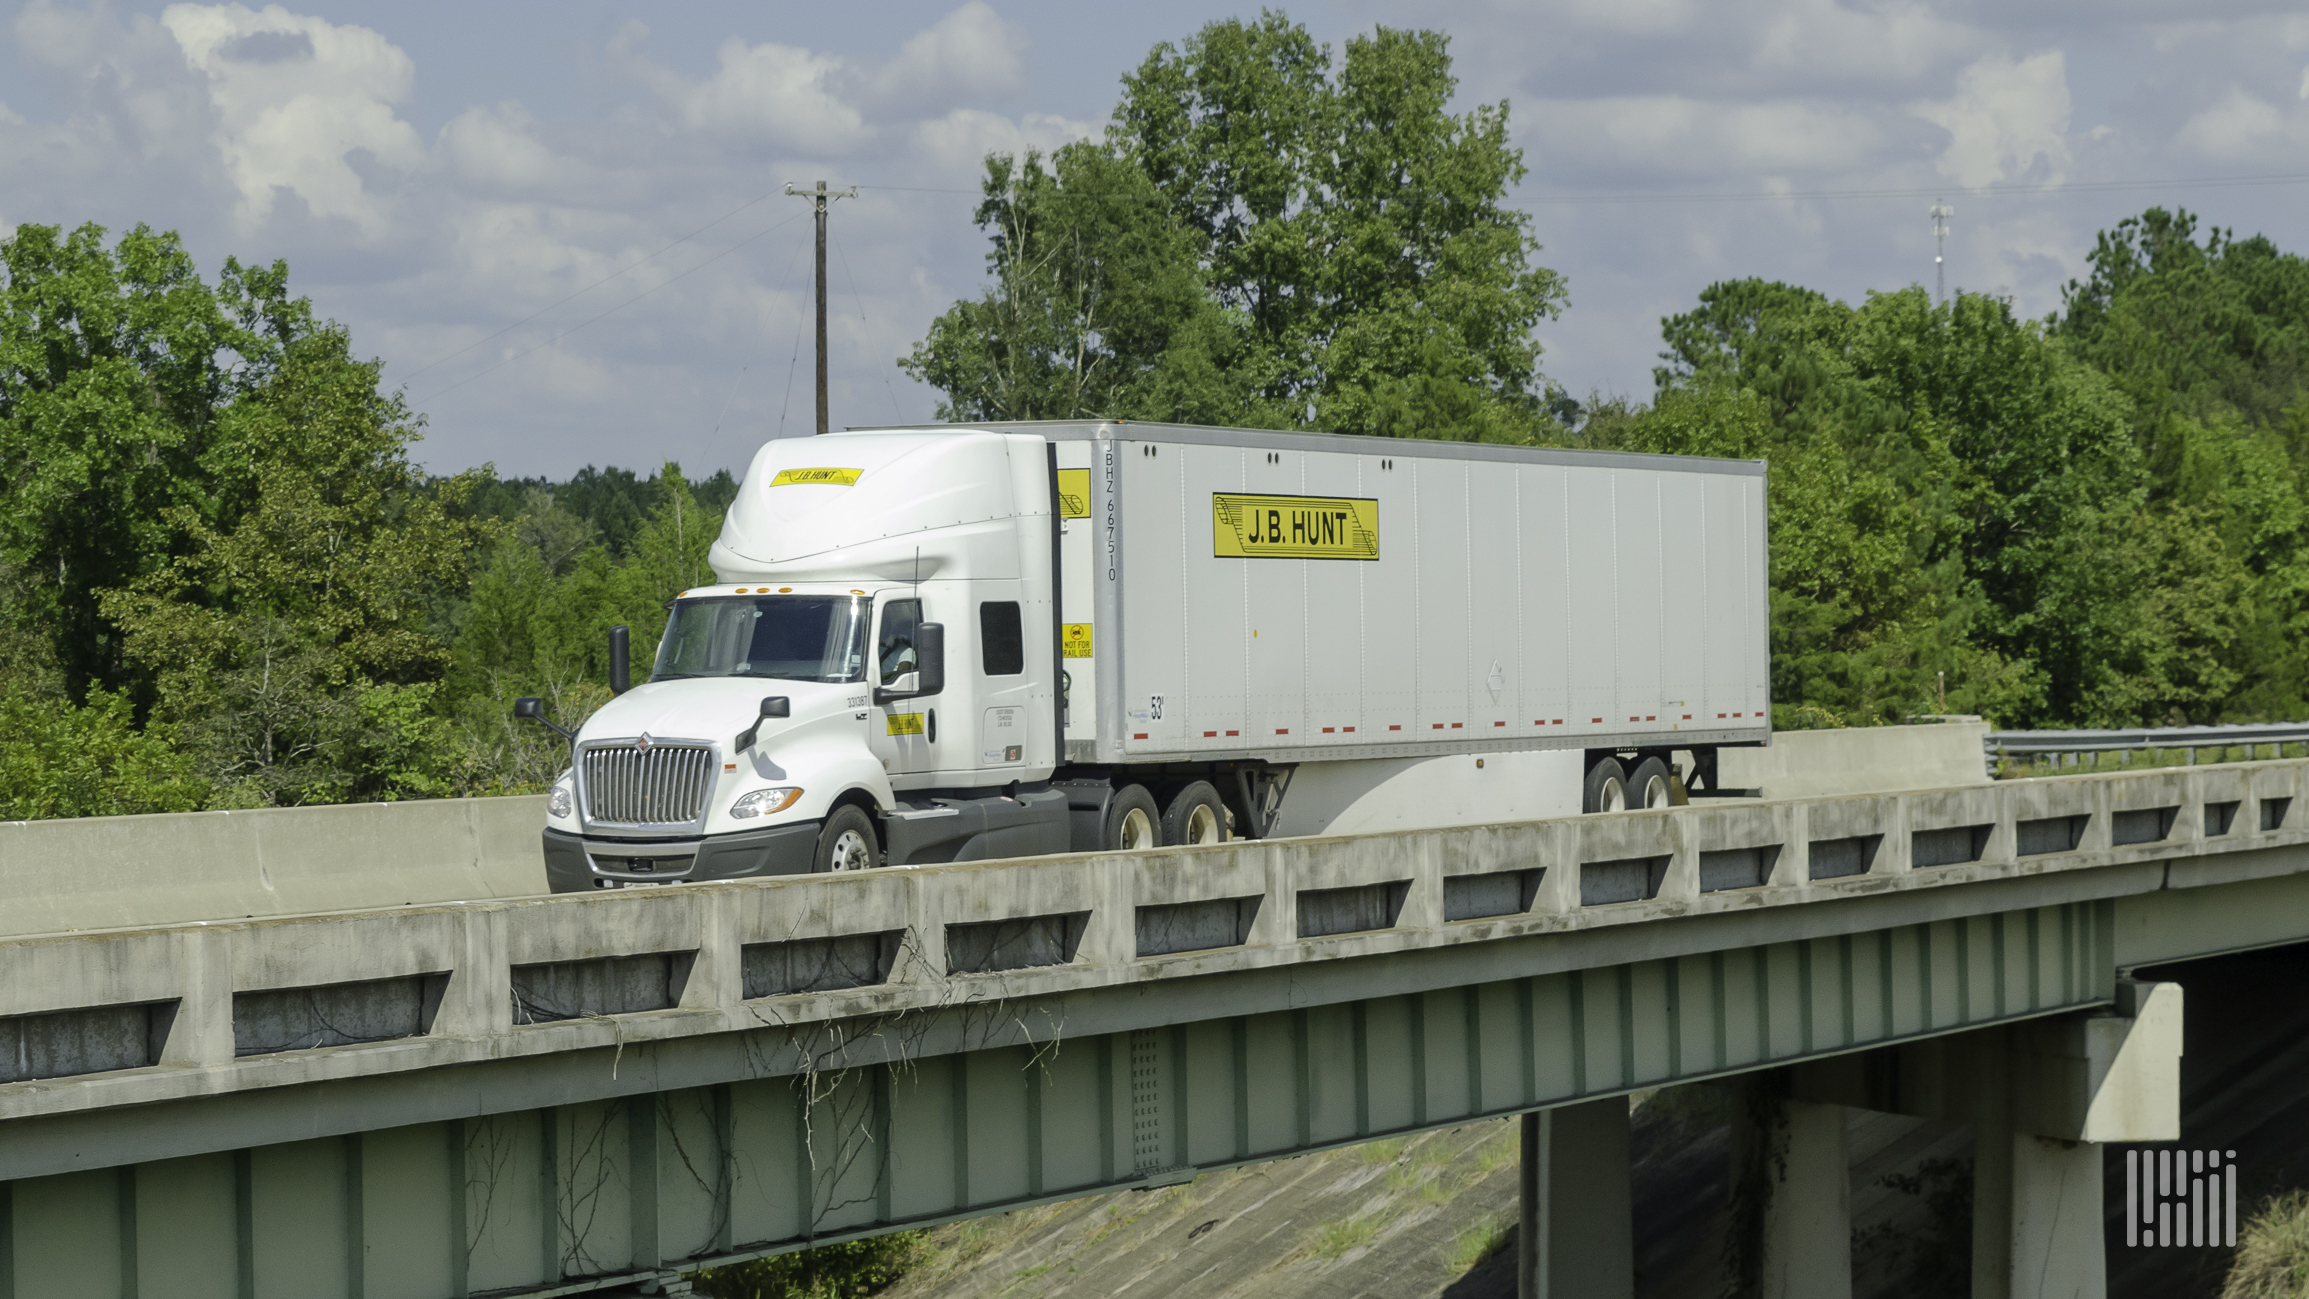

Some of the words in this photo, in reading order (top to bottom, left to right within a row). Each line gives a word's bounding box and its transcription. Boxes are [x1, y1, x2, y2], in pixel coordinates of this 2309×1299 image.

[1106, 440, 1114, 493] JBHZ
[810, 470, 837, 480] HUNT
[1249, 509, 1286, 544] J.B.
[1292, 510, 1347, 545] HUNT
[1107, 499, 1116, 581] 667510
[1064, 640, 1077, 649] NOT
[1078, 640, 1091, 649] FOR
[1063, 649, 1078, 658] RAIL
[1079, 649, 1092, 657] USE
[847, 695, 867, 708] 331387
